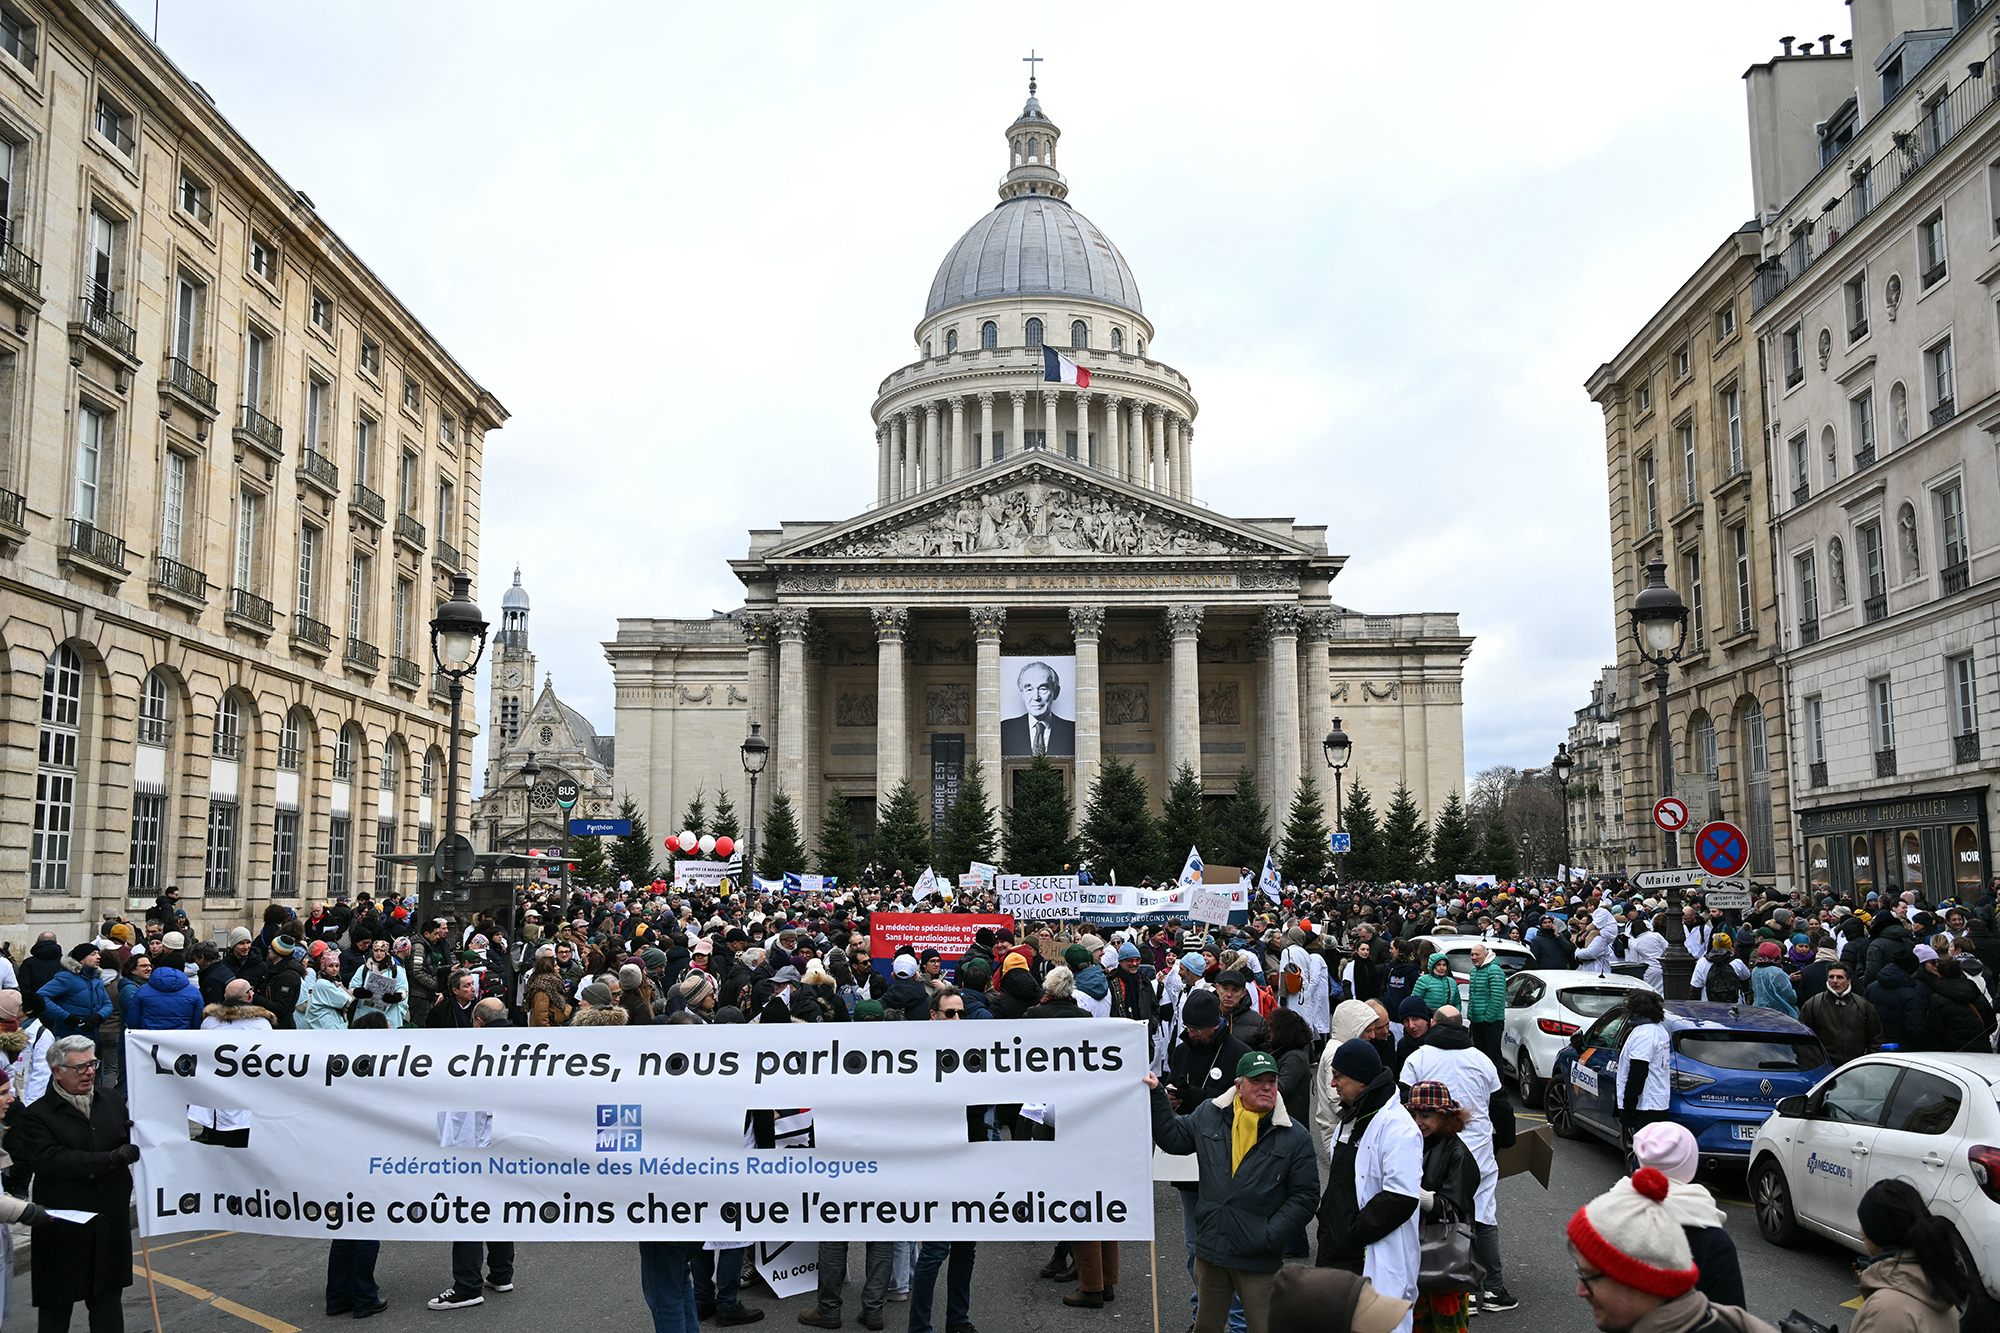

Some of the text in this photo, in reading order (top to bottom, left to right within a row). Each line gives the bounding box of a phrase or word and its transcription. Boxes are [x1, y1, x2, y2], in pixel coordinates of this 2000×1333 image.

[843, 576, 1232, 588] AUX GRANDS HOMMES LA PATRIE RECONNAISSANTE
[558, 786, 576, 796] BUS
[1963, 800, 1969, 811] 3
[1821, 800, 1948, 827] PHARMACIE LHOPITALLIER
[1806, 817, 1812, 827] 3
[1960, 850, 1980, 862] NOIR
[1003, 877, 1073, 891] LE SECRET
[1645, 875, 1681, 886] Mairie
[1000, 891, 1078, 905] MÉDICAL N'EST
[1081, 895, 1116, 904] SNMV
[1140, 894, 1178, 906] SNMV
[1003, 906, 1079, 919] PAS NÉGOCIABLE
[1116, 914, 1130, 923] DES
[1131, 913, 1165, 922] MÉDECINS
[876, 923, 885, 931] La
[885, 923, 920, 932] médecine
[921, 924, 961, 933] spécialisée
[885, 933, 902, 941] Sans
[914, 934, 962, 944] cardiologues,
[963, 934, 971, 942] le
[150, 1036, 1124, 1086] La Sécu parle chiffres, nous parlons patients
[369, 1156, 879, 1179] Fédération Nationale des Médecins Radiologues
[1817, 1158, 1846, 1177] MÉDECINS
[156, 1187, 1128, 1231] La radiologie coûte moins cher que l'erreur médicale
[772, 1269, 788, 1282] Au
